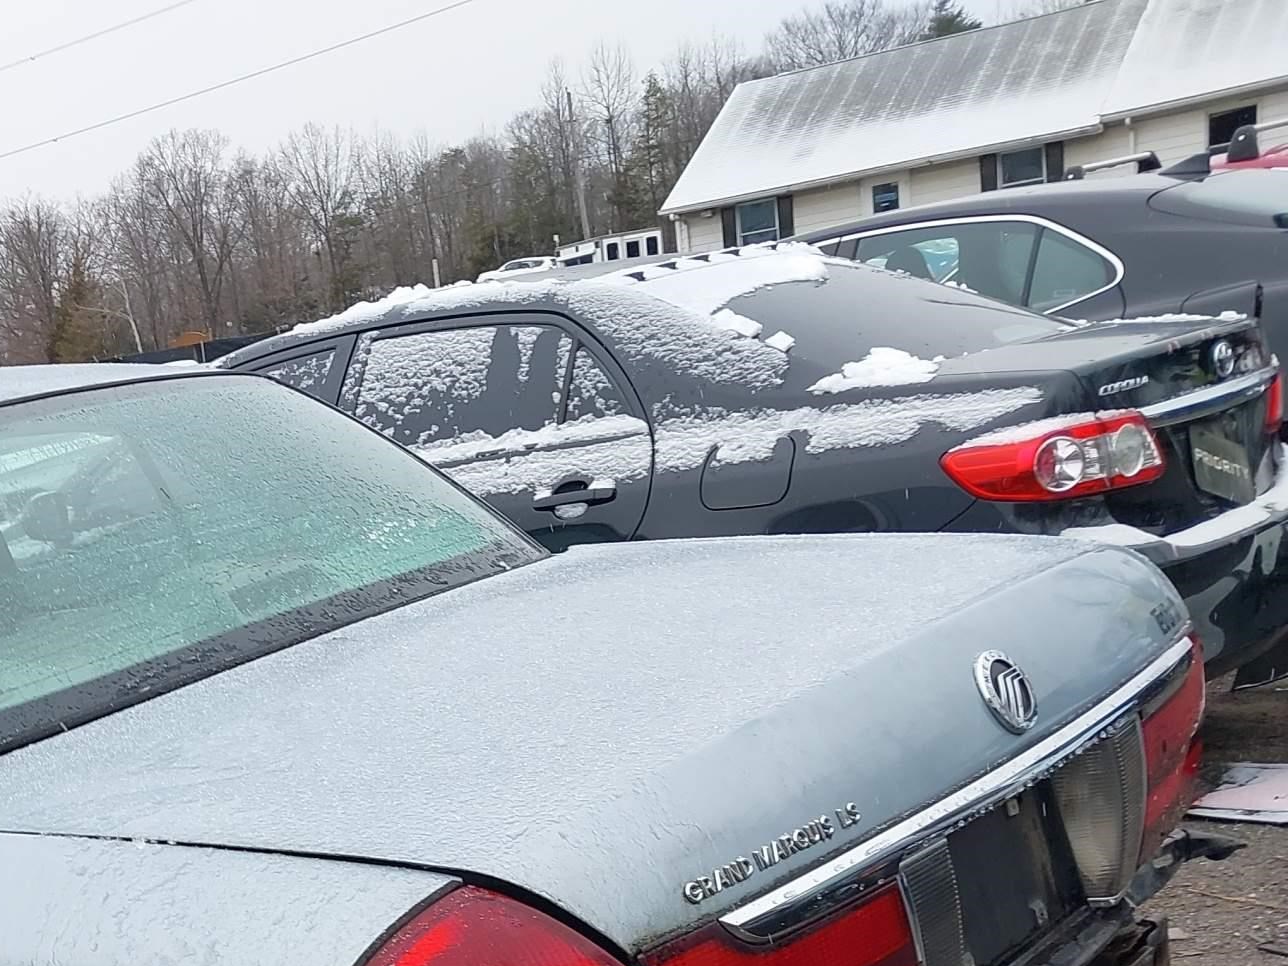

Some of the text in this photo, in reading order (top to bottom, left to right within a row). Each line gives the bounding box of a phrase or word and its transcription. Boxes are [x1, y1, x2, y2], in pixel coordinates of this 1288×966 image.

[1098, 375, 1149, 396] COROLLA
[1194, 447, 1249, 479] PRIORITY
[684, 801, 861, 904] GRAND MARQUIS LS
